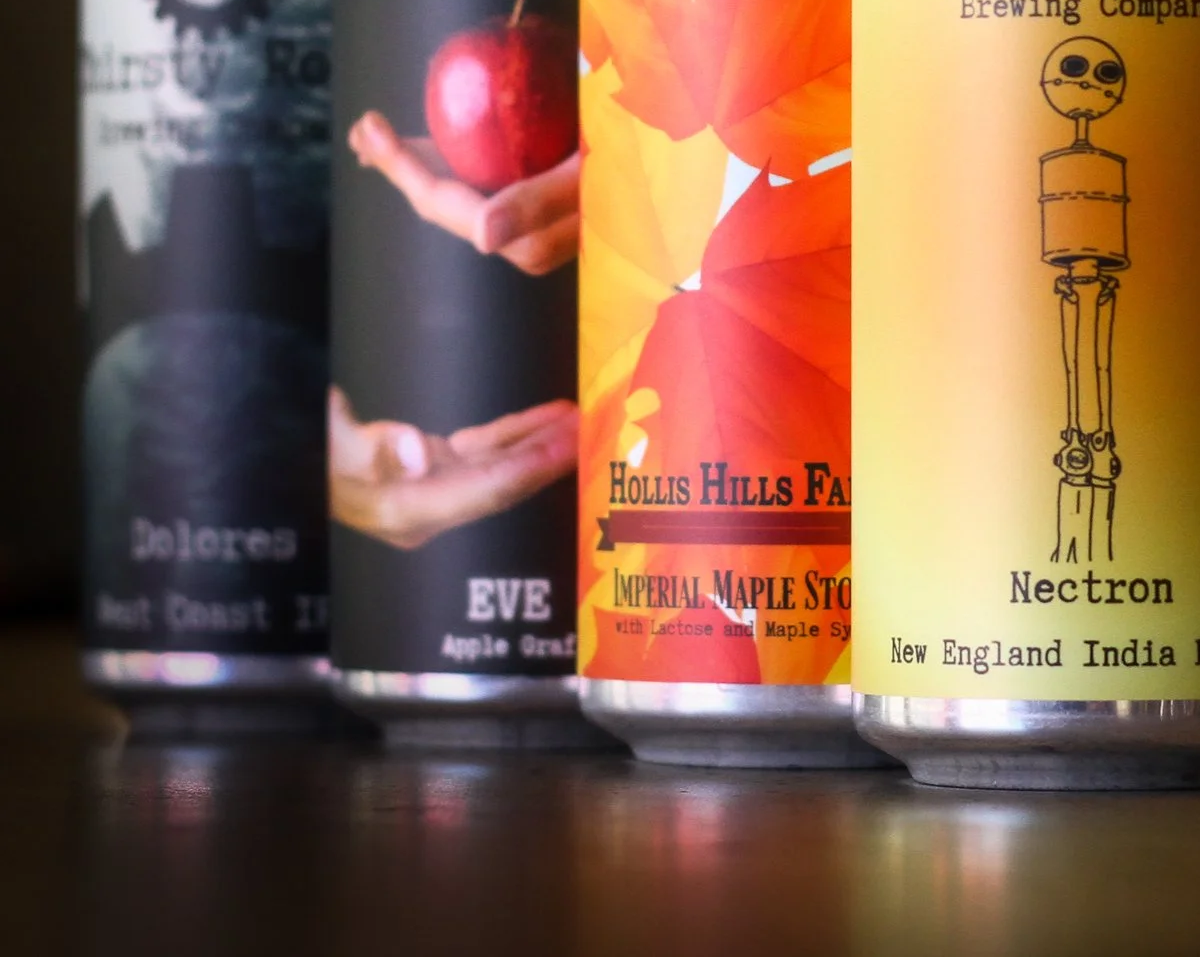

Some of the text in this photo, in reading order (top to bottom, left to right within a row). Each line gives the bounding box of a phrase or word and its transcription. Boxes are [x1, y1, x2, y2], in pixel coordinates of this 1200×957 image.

[610, 461, 852, 506] HOLLIS HILLS FA
[468, 577, 551, 621] EVE
[614, 568, 704, 609] IMPERIAL
[713, 570, 796, 610] MAPLE
[1010, 571, 1174, 604] Nectron
[441, 633, 509, 662] Apple
[616, 619, 642, 633] with
[651, 620, 713, 636] Lactose
[724, 622, 753, 637] and
[766, 621, 819, 641] Maple
[891, 637, 927, 664] New
[942, 639, 1062, 675] England
[1083, 639, 1176, 667] India
